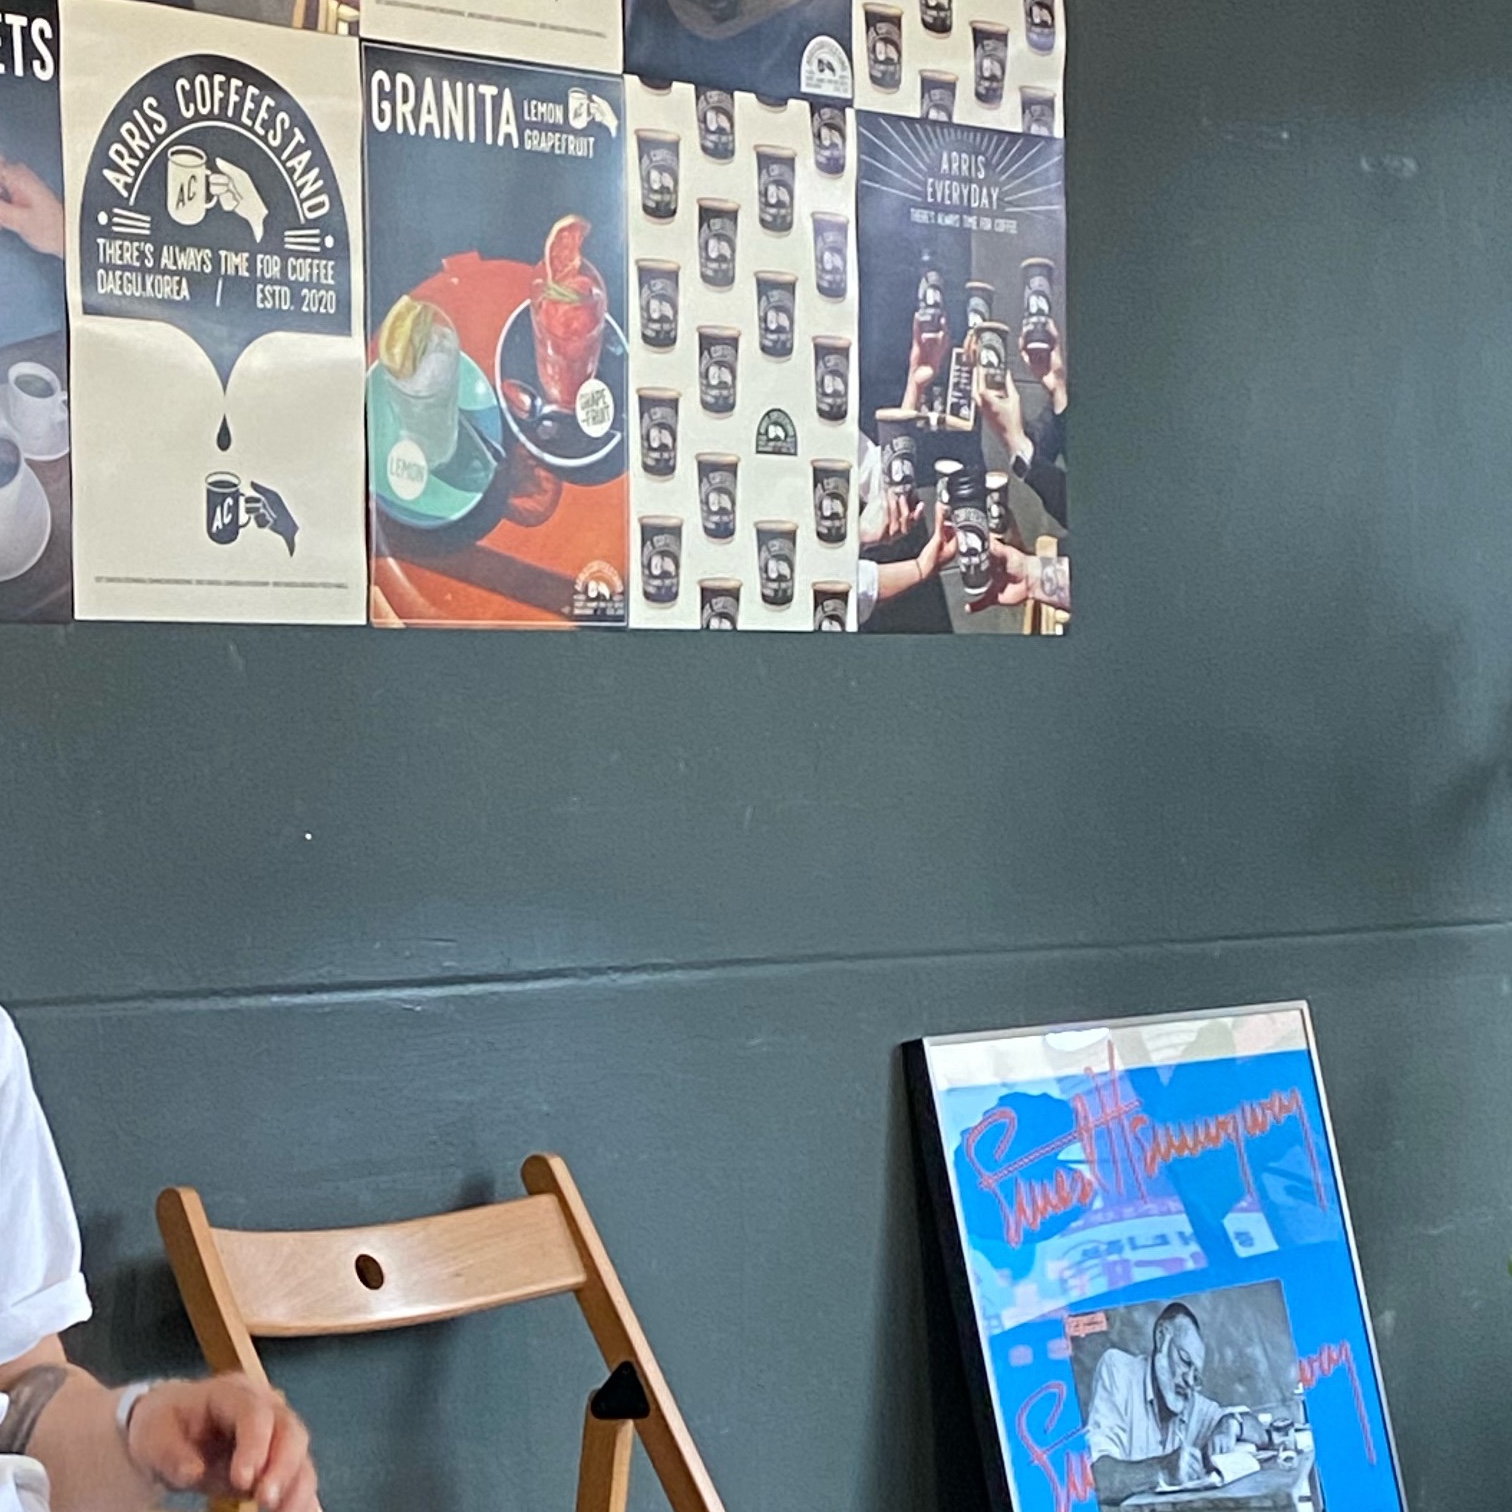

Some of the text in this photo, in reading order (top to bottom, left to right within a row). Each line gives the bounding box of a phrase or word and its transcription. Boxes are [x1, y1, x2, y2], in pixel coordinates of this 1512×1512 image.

[370, 69, 520, 150] GRANITA
[523, 98, 564, 126] LEMON
[101, 73, 331, 221] ARRIS COFFEESTAND
[523, 129, 595, 159] GRAPEFRUIT
[940, 151, 987, 180] ARRIS
[926, 179, 1001, 210] EVERYDAY
[96, 238, 336, 285] THERE'S ALWAYS TIME FOR COFFEE
[96, 269, 191, 301] DAEGU.KOREA
[256, 284, 295, 311] ESTD.
[301, 289, 337, 315] 2020
[211, 496, 234, 533] AC
